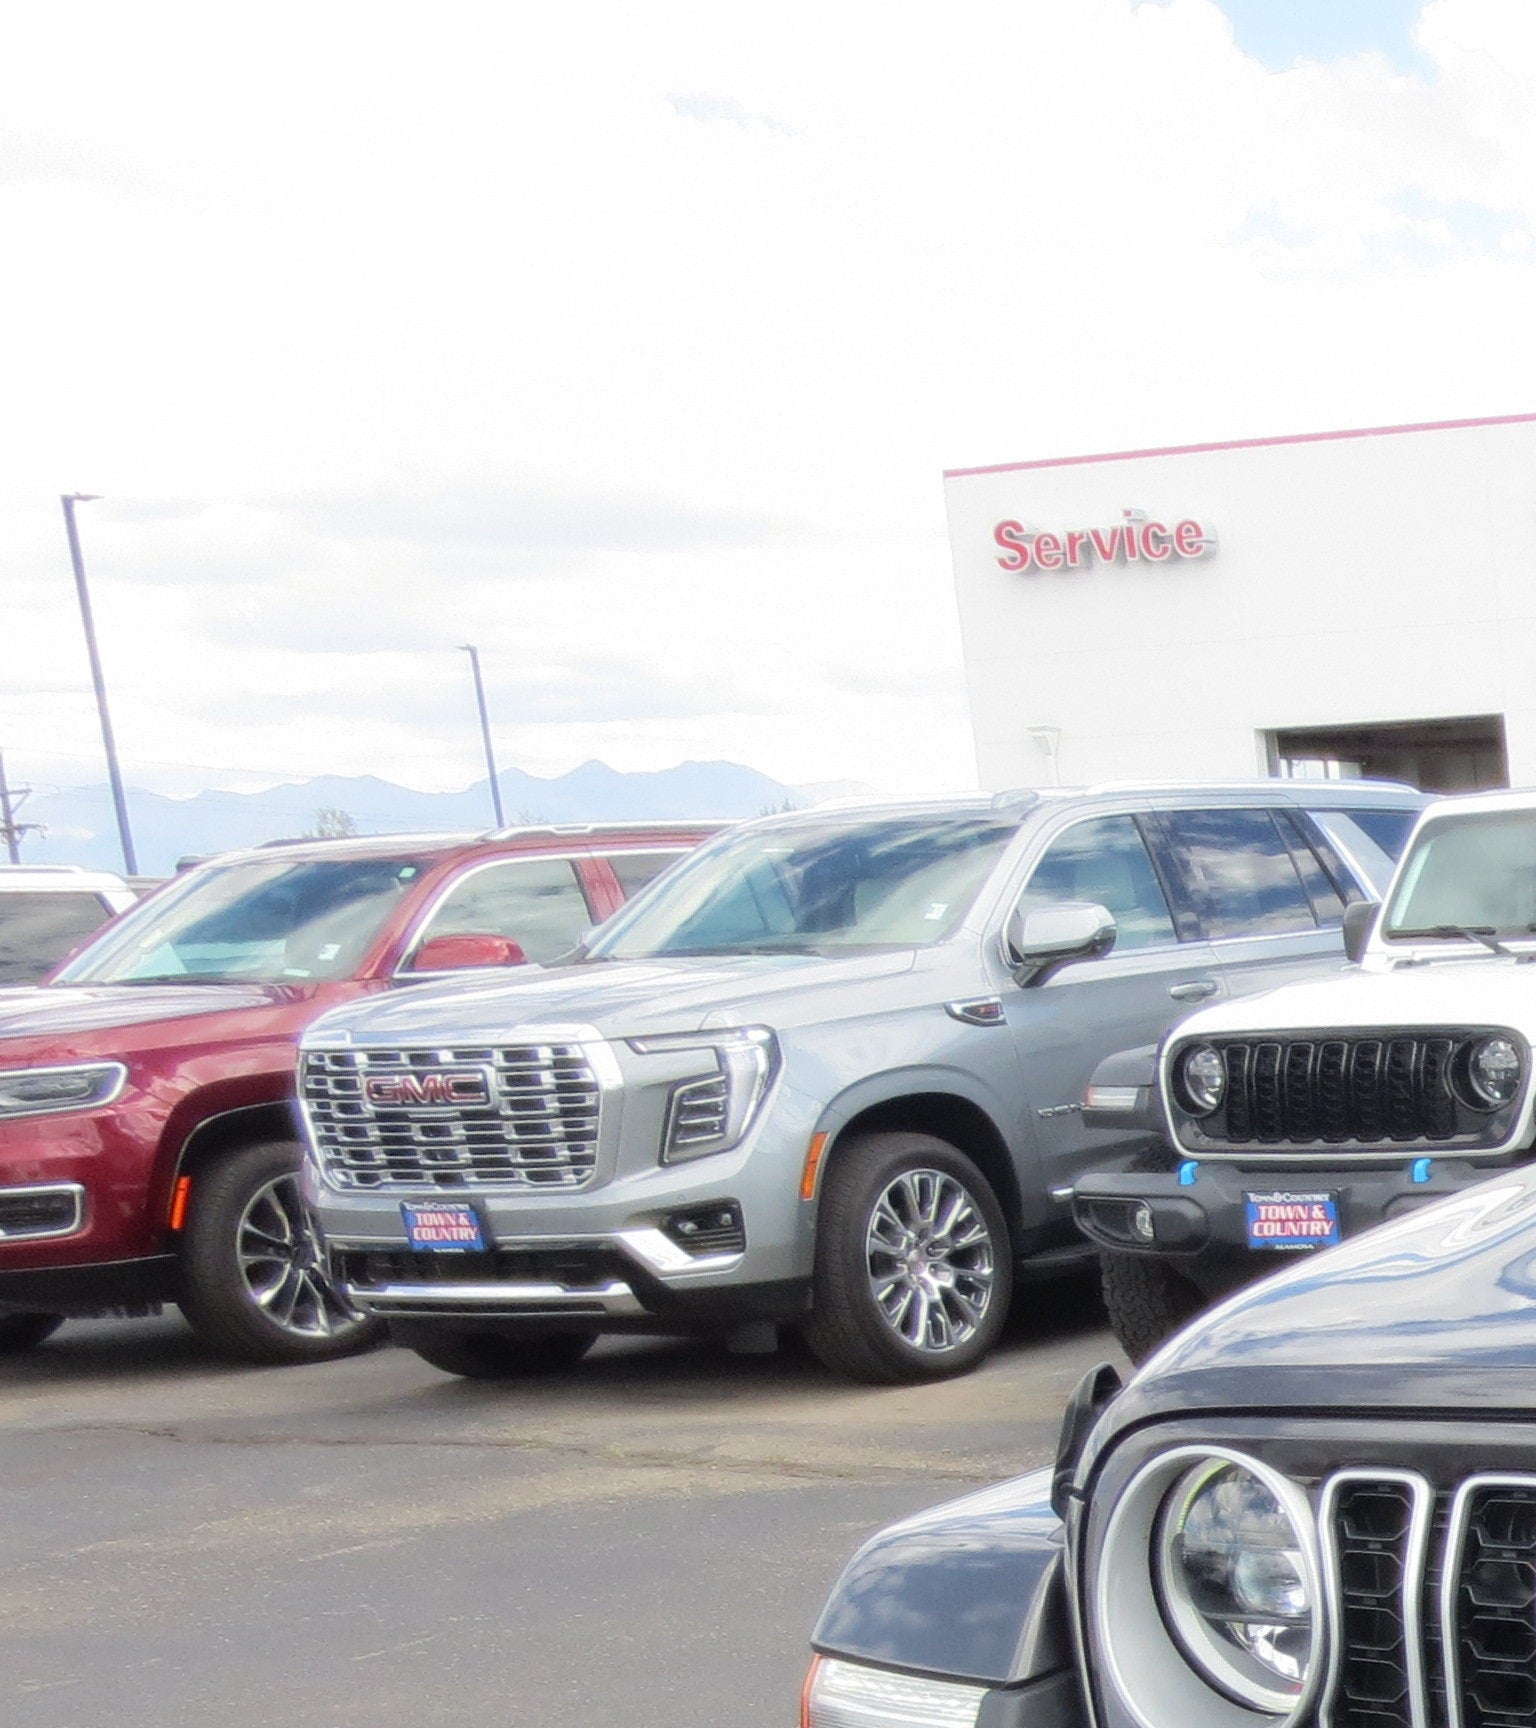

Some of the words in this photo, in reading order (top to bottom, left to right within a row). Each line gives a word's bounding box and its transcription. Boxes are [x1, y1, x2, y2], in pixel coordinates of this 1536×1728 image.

[993, 508, 1206, 573] Service
[365, 1073, 486, 1104] GMC
[414, 1212, 457, 1227] TOWN
[1257, 1203, 1309, 1220] TOWN
[1311, 1203, 1327, 1220] &
[412, 1226, 478, 1242] COUNTRY
[1252, 1220, 1334, 1238] COUNTRY
